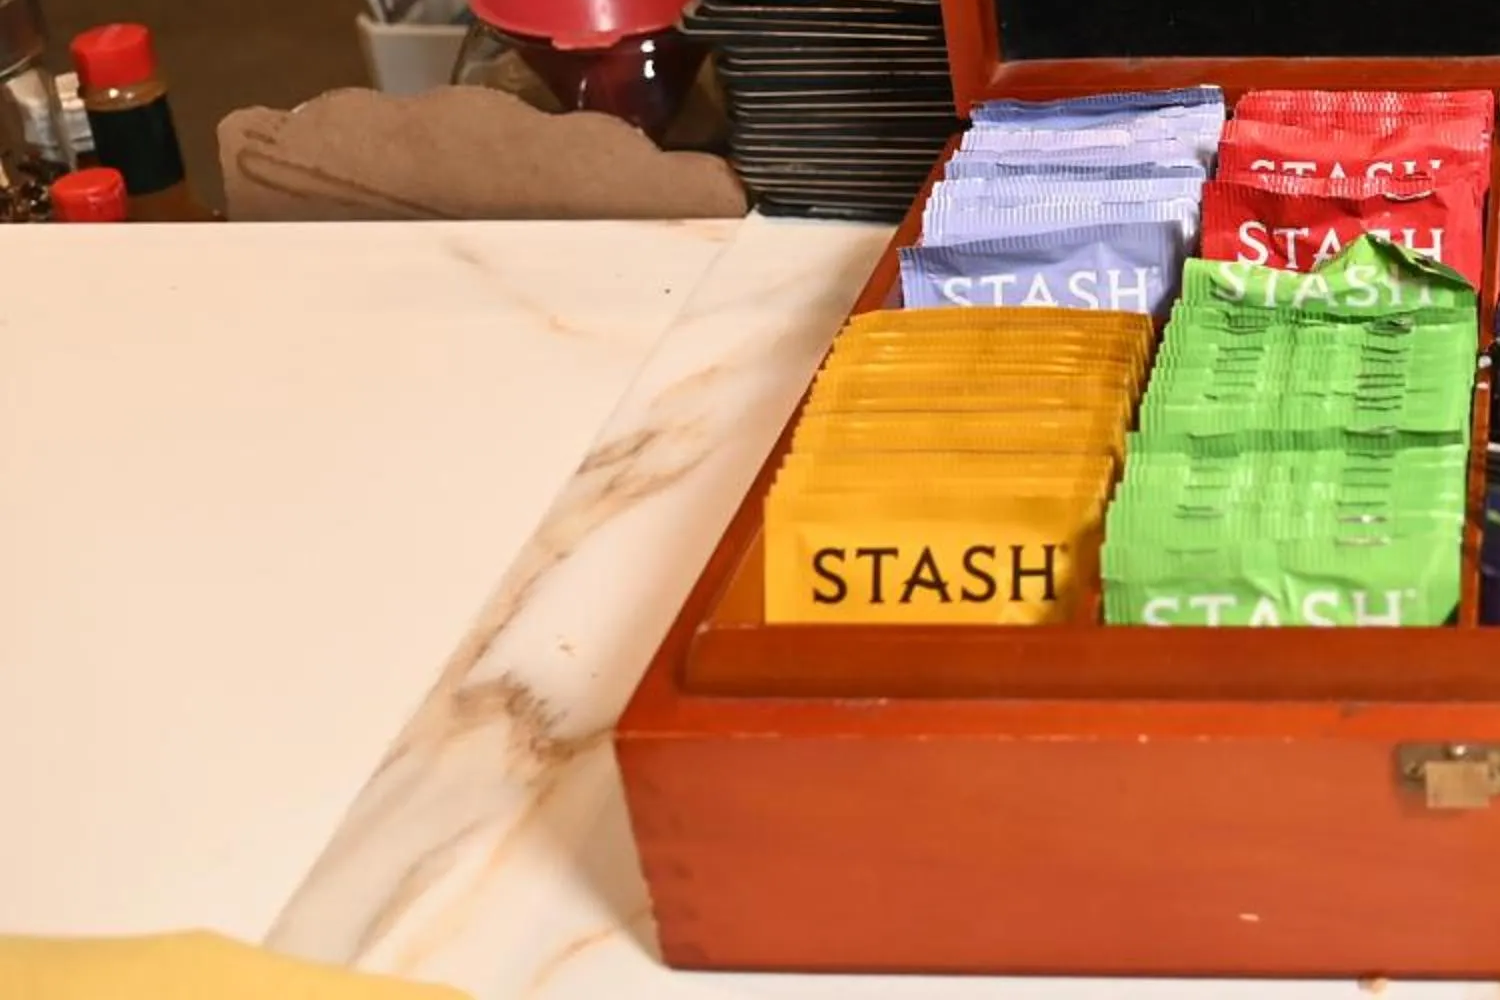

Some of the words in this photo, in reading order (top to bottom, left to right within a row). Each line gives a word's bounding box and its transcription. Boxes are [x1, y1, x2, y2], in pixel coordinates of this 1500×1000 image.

[1236, 221, 1444, 270] STAH
[943, 266, 1150, 314] STASH
[811, 544, 1058, 605] STASH
